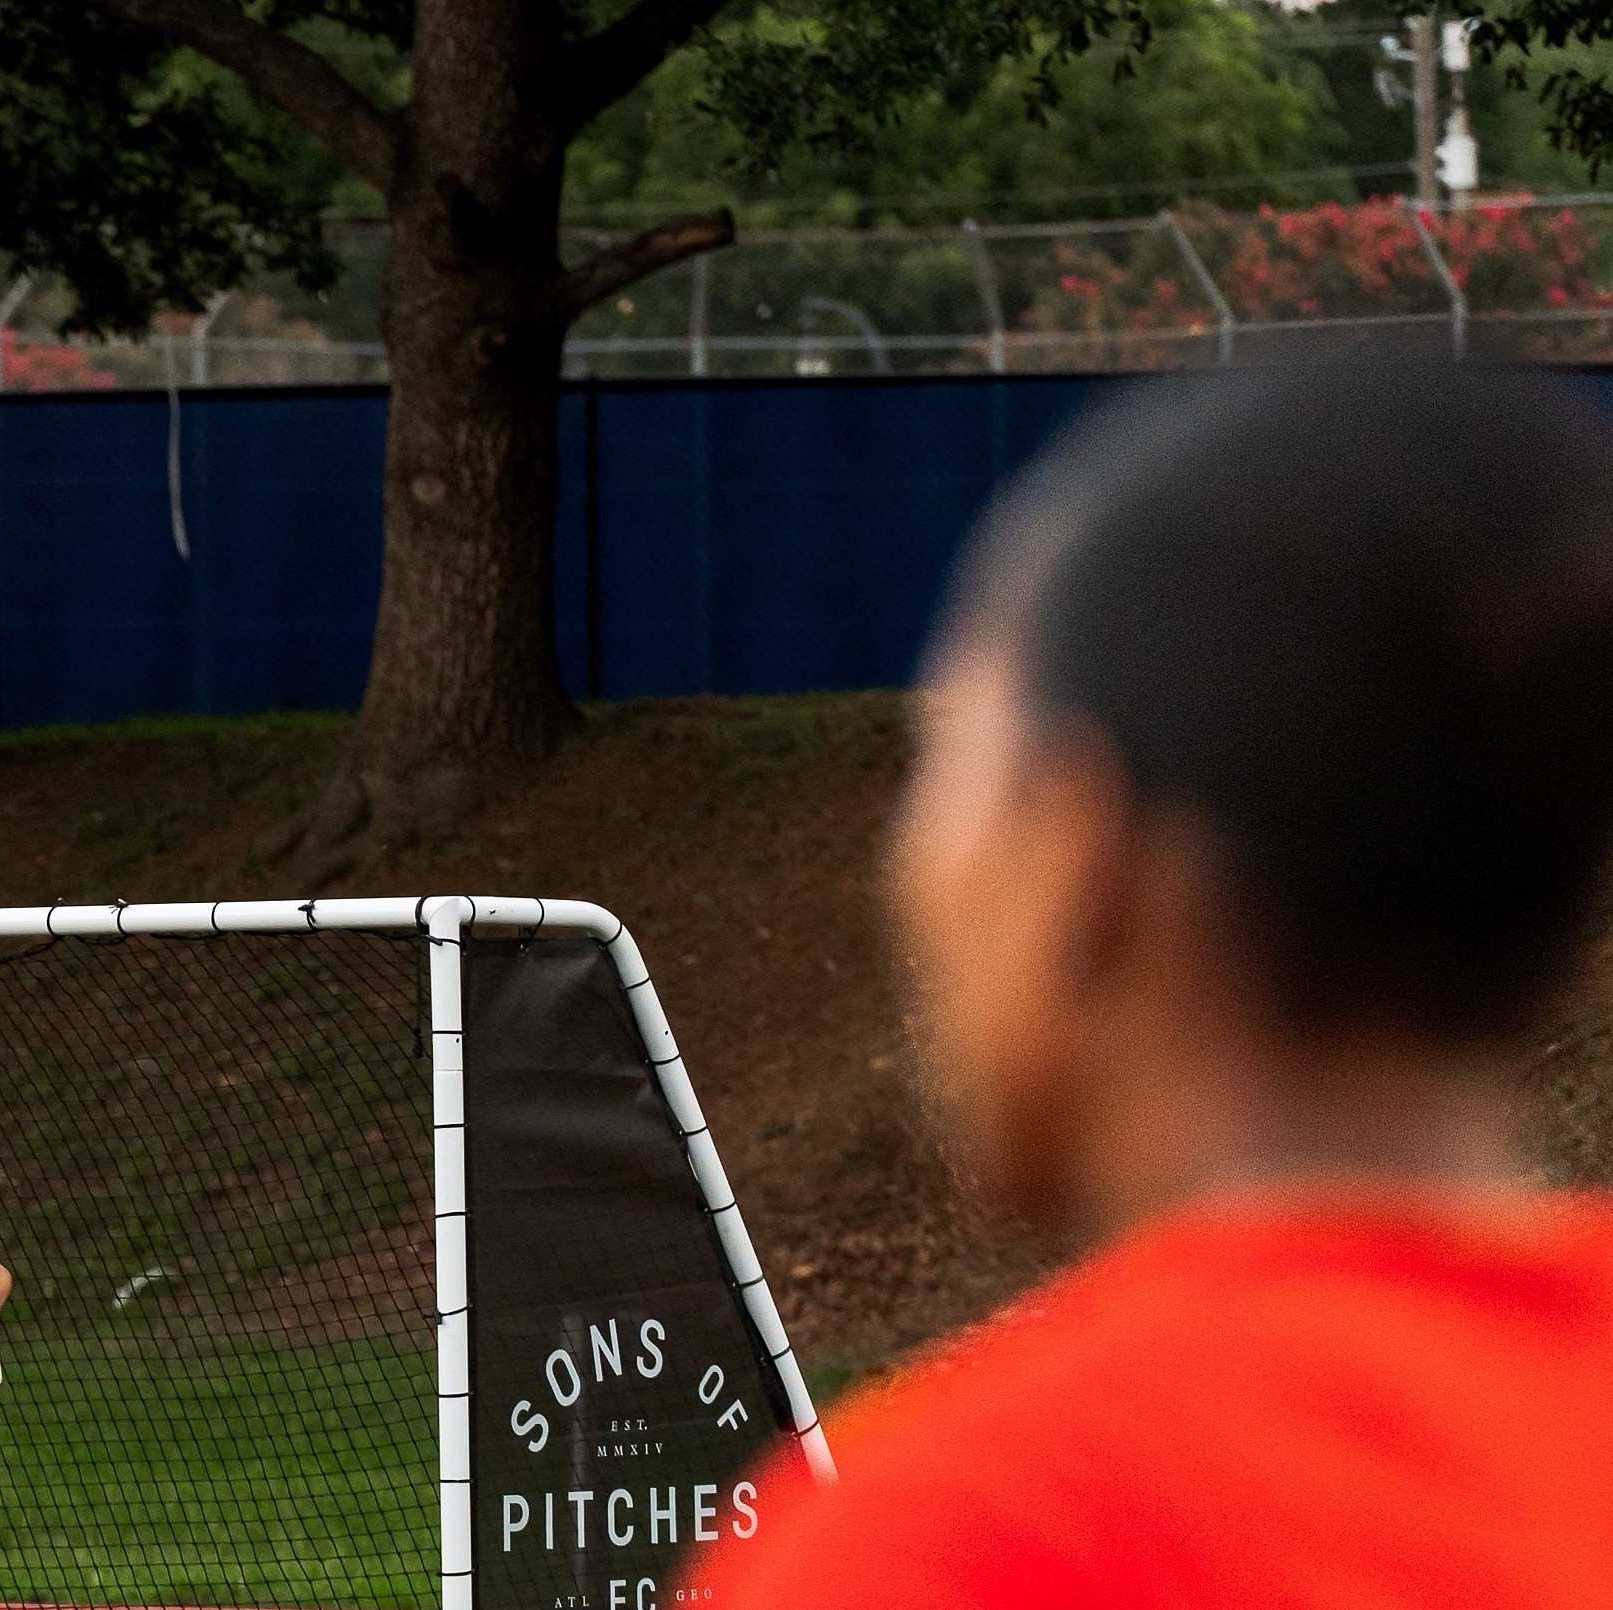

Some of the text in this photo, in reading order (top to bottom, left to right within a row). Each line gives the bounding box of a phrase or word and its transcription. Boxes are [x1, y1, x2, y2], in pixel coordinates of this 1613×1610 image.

[511, 1319, 749, 1453] SONS OF
[611, 1419, 648, 1432] EST.
[597, 1442, 664, 1457] MMXIV
[502, 1481, 759, 1552] PITCHES
[554, 1595, 590, 1609] ATL
